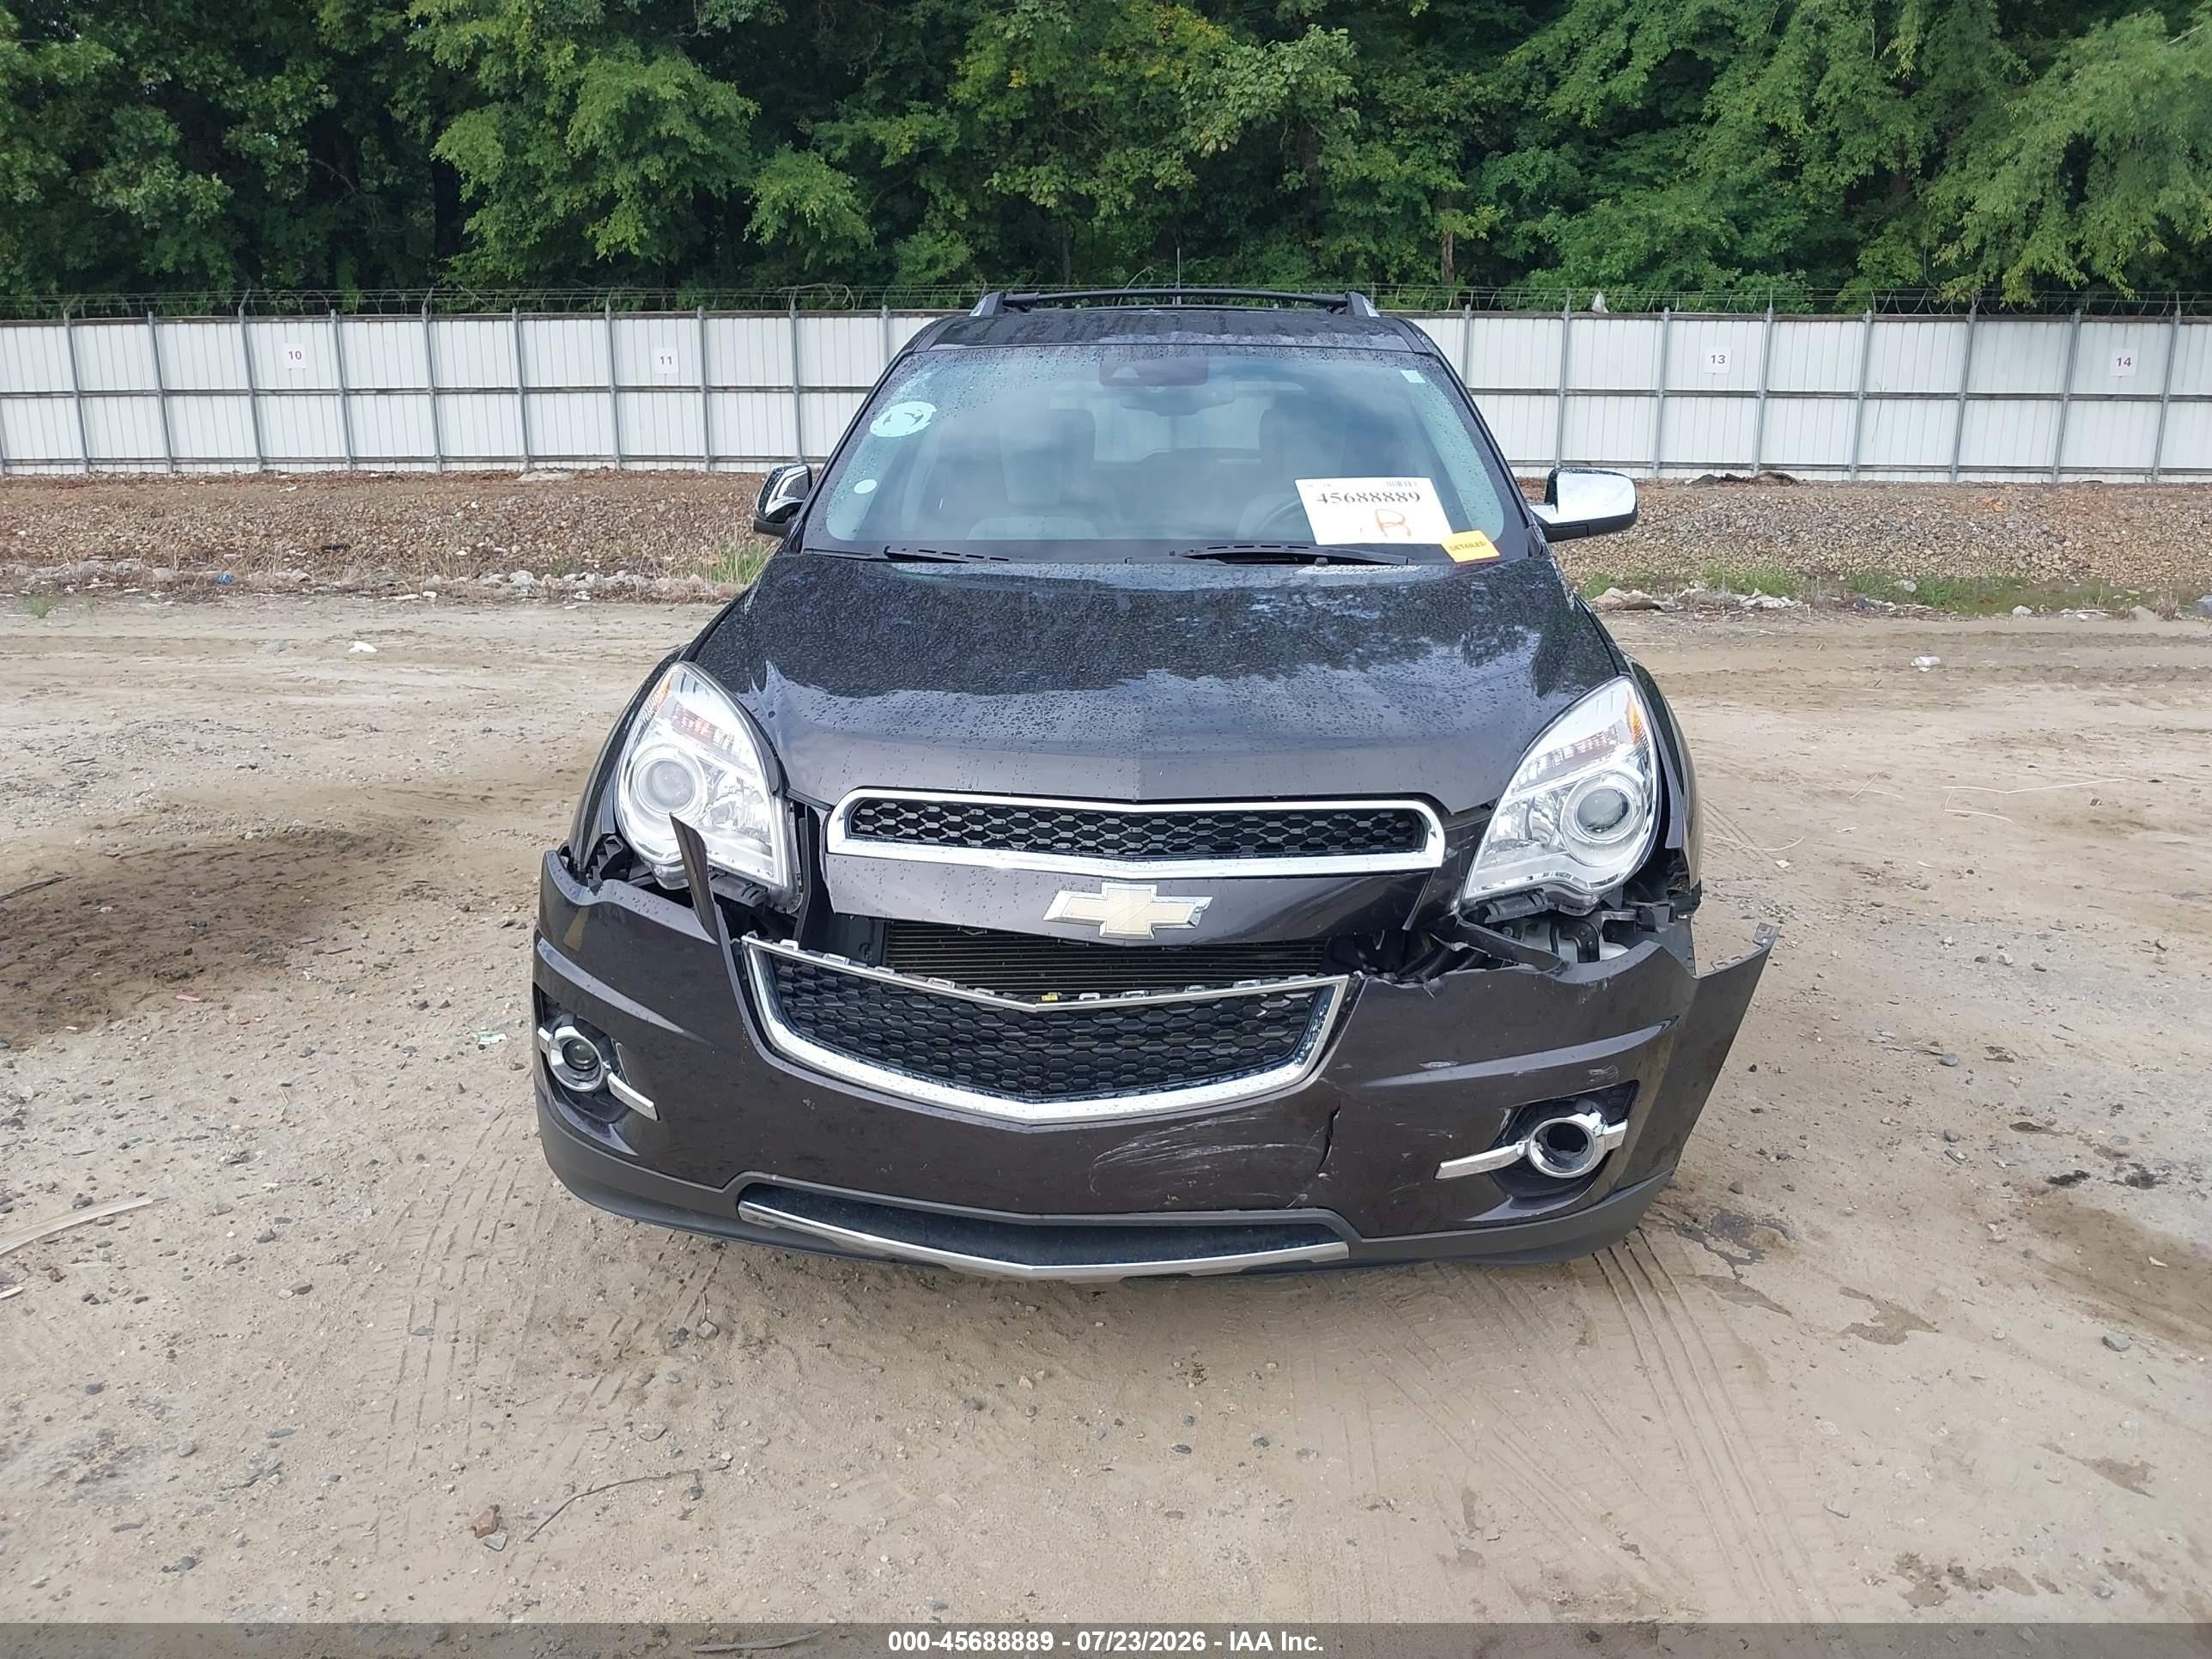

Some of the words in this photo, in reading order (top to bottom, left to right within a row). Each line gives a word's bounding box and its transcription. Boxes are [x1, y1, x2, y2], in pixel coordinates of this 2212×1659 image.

[288, 350, 302, 361] 10
[659, 356, 672, 365] 11
[1710, 354, 1726, 364] 13
[2116, 356, 2132, 368] 14
[1316, 491, 1421, 504] 45688889
